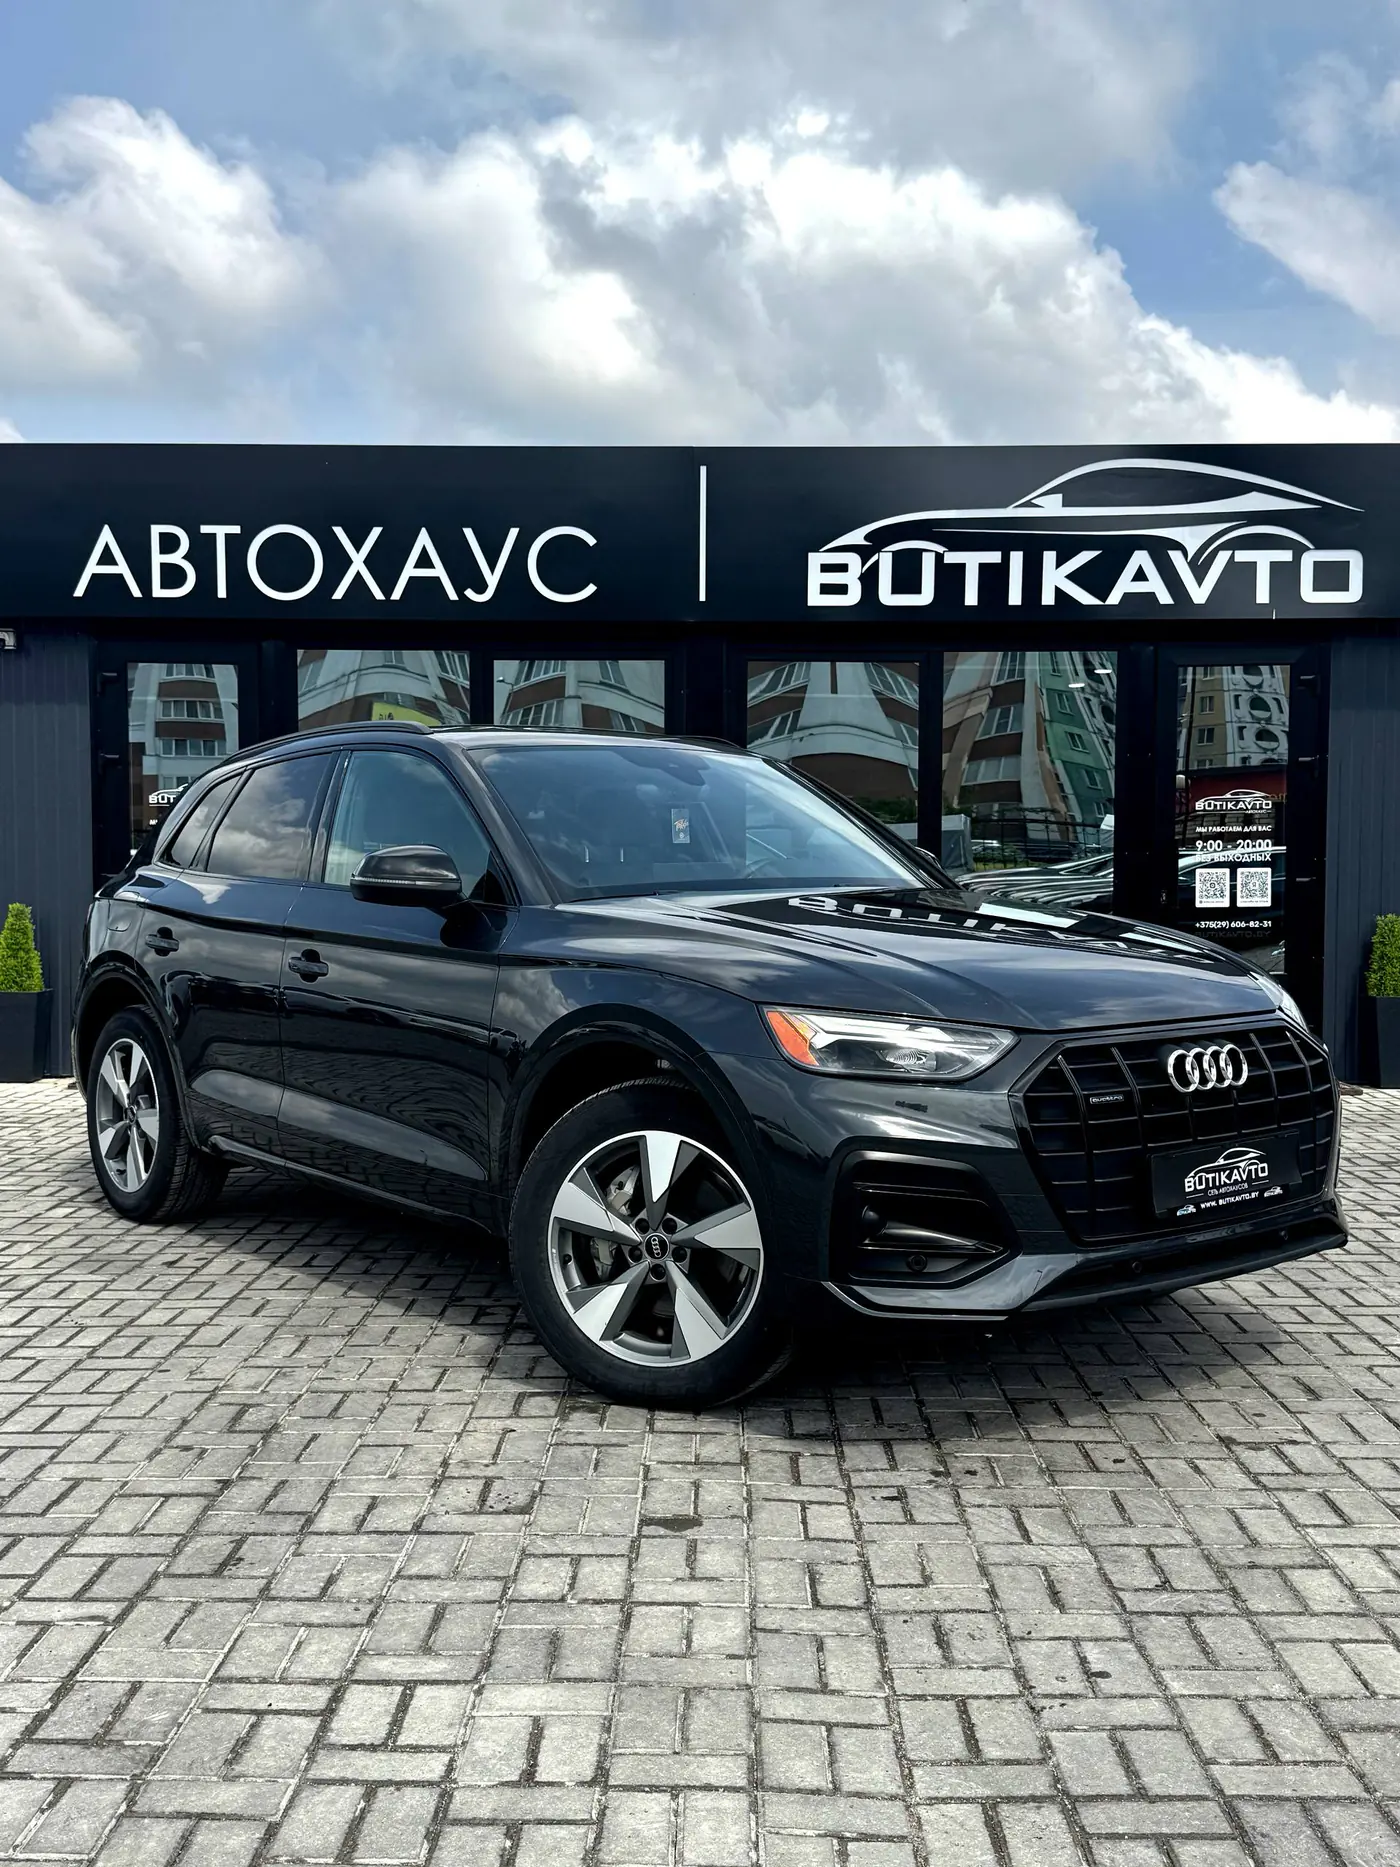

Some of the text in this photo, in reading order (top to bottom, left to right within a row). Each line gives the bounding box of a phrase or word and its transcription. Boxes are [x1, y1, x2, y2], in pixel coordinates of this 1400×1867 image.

[72, 523, 598, 603] АВТОХАУС
[806, 548, 1364, 607] BUTIKAVTO
[1195, 800, 1272, 810] BUTIKAVTO
[1195, 839, 1223, 851] 9:00
[1236, 839, 1272, 850] 20:00
[1195, 852, 1272, 862] БЕЗ ВЫХОДНЫХ
[1195, 920, 1272, 929] +375(29) 606-82-31
[1184, 1162, 1269, 1193] BUTIKAVTO
[1207, 1182, 1249, 1196] СЕТЬ АВТОХАУСОВ
[1218, 1191, 1259, 1206] BUTIKAVTO.BY
